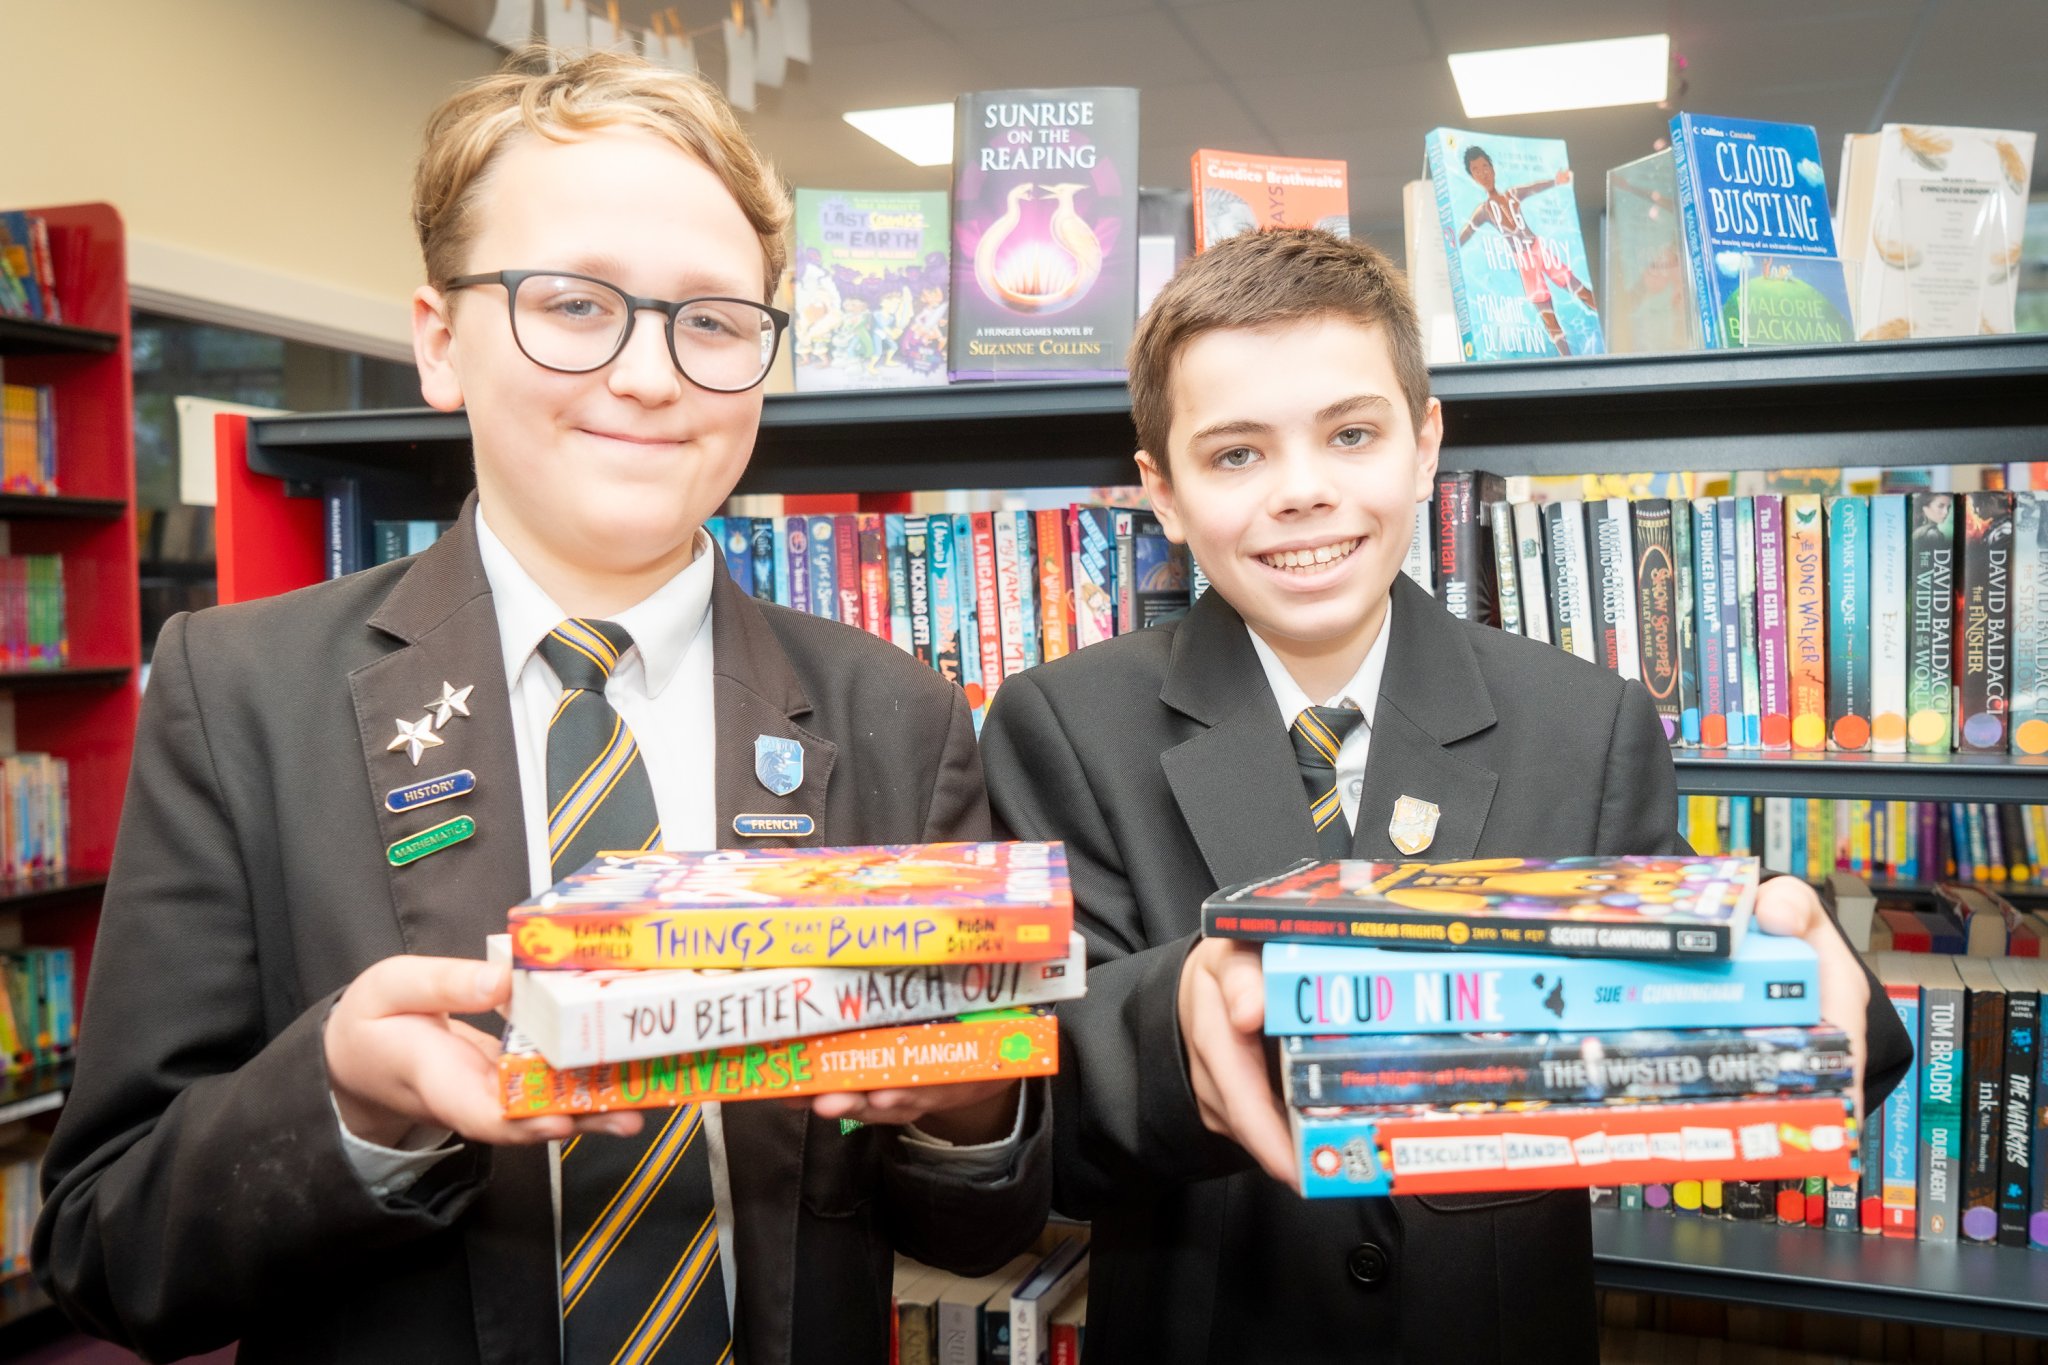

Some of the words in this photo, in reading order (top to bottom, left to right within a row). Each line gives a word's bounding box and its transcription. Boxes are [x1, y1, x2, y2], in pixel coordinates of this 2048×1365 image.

[985, 101, 1094, 128] SUNRISE
[1007, 130, 1032, 144] ON
[1038, 129, 1070, 143] THE
[980, 146, 1096, 171] REAPING
[1207, 165, 1264, 183] Candice
[1266, 169, 1344, 189] Brathwaite
[1715, 141, 1795, 188] CLOUD
[823, 211, 866, 227] LAST
[1268, 185, 1286, 224] AYS
[1708, 187, 1819, 242] BUSTING
[823, 230, 845, 241] ON
[849, 230, 919, 248] EARTH
[1482, 235, 1538, 271] HEART
[1539, 239, 1574, 270] BOY
[1738, 296, 1826, 319] MALORIE
[984, 328, 1021, 337] HUNGER
[1022, 328, 1050, 337] GAMES
[1053, 327, 1081, 337] NOVEL
[1083, 327, 1094, 336] BY
[1017, 520, 1028, 552] DAVID
[1440, 482, 1461, 573] blackman
[1700, 507, 1713, 529] THE
[1760, 508, 1772, 528] The
[1842, 504, 1856, 532] ONE
[1552, 517, 1578, 566] NOUGHTS
[1598, 518, 1623, 566] NOUGHTS
[1700, 529, 1715, 580] BUNKER
[1720, 518, 1734, 557] JOHNNY
[1842, 532, 1857, 570] DARK
[1020, 556, 1031, 600] ALMOND
[1760, 531, 1778, 591] H-BOMB
[1796, 553, 1820, 596] SONG
[893, 570, 906, 607] COLOUR
[911, 558, 927, 615] KICKING
[936, 575, 948, 600] THE
[975, 533, 996, 637] LANCASHIRE
[1001, 559, 1020, 617] NAME
[1043, 574, 1061, 603] WITH
[1556, 576, 1581, 623] CROSSES
[1601, 576, 1626, 623] CROSSES
[1651, 567, 1673, 611] SHOW
[1721, 559, 1737, 606] DELGADO
[1839, 571, 1857, 625] THRONE
[1930, 549, 1951, 614] DAVID
[1987, 548, 2007, 613] DAVID
[2034, 550, 2048, 614] DAVID
[1641, 589, 1651, 623] HAYLEY
[1702, 582, 1718, 622] DIARY
[1763, 593, 1779, 629] GIRL
[1915, 570, 1934, 631] WIDTH
[2017, 584, 2038, 633] STARS
[914, 615, 930, 646] OFF!
[936, 606, 956, 654] DARK
[1046, 620, 1062, 646] FIRE
[1642, 624, 1653, 659] BARKER
[1650, 613, 1675, 681] STOPPER
[1725, 624, 1737, 648] KEVIN
[1797, 600, 1822, 665] WALKER
[1965, 604, 1988, 675] FINISHER
[1706, 638, 1718, 672] KEVIN
[1726, 652, 1738, 684] BROOKS
[1765, 639, 1775, 681] STEPHEN
[1930, 618, 1950, 711] BALDACCI
[1985, 618, 2006, 715] BALDACCI
[1708, 674, 1720, 714] BROOK
[1766, 683, 1776, 714] BAXTE
[1910, 649, 1933, 712] WORLD
[404, 778, 455, 803] HISTORY
[393, 822, 468, 860] MATHEMATICS
[750, 818, 798, 831] FRENCH
[644, 918, 775, 961] THINGS
[783, 920, 823, 934] THAT
[827, 916, 937, 958] BUMP
[1215, 917, 1240, 931] FIVE
[1240, 918, 1278, 933] NIGHTS
[1279, 919, 1294, 933] AT
[1294, 920, 1347, 936] FREDDY'S
[1350, 921, 1400, 939] FAZBEAR
[1400, 923, 1447, 941] FRIGHTS
[1471, 926, 1499, 941] INTO
[1500, 928, 1522, 942] THE
[1550, 926, 1599, 947] SCOTT
[1599, 927, 1672, 950] CAWTHON
[624, 1000, 676, 1043] YOU
[695, 977, 824, 1042] BETTER
[836, 964, 946, 1022] WATCH
[962, 962, 1023, 1003] OUT
[1295, 974, 1394, 1025] CLOUD
[1413, 972, 1505, 1024] NINE
[1595, 986, 1623, 1004] SUE
[1642, 983, 1745, 1004] CUNNINGHAM
[1932, 1002, 1955, 1037] TOM
[620, 1042, 813, 1103] UNIVERSE
[820, 1046, 896, 1073] STEPHEN
[903, 1040, 979, 1067] MANGAN
[1539, 1059, 1584, 1088] THE
[1599, 1054, 1701, 1087] TWISTED
[1707, 1052, 1779, 1083] ONES
[1929, 1039, 1954, 1104] BRADBY
[1979, 1081, 1999, 1112] ink
[2009, 1073, 2031, 1099] THE
[1980, 1111, 1992, 1132] Alice
[2004, 1099, 2030, 1168] NATURALS
[1396, 1143, 1499, 1167] BISCUITS
[1506, 1142, 1568, 1161] BANDS
[1930, 1127, 1948, 1167] DOUBLE
[1930, 1166, 1948, 1203] AGENT
